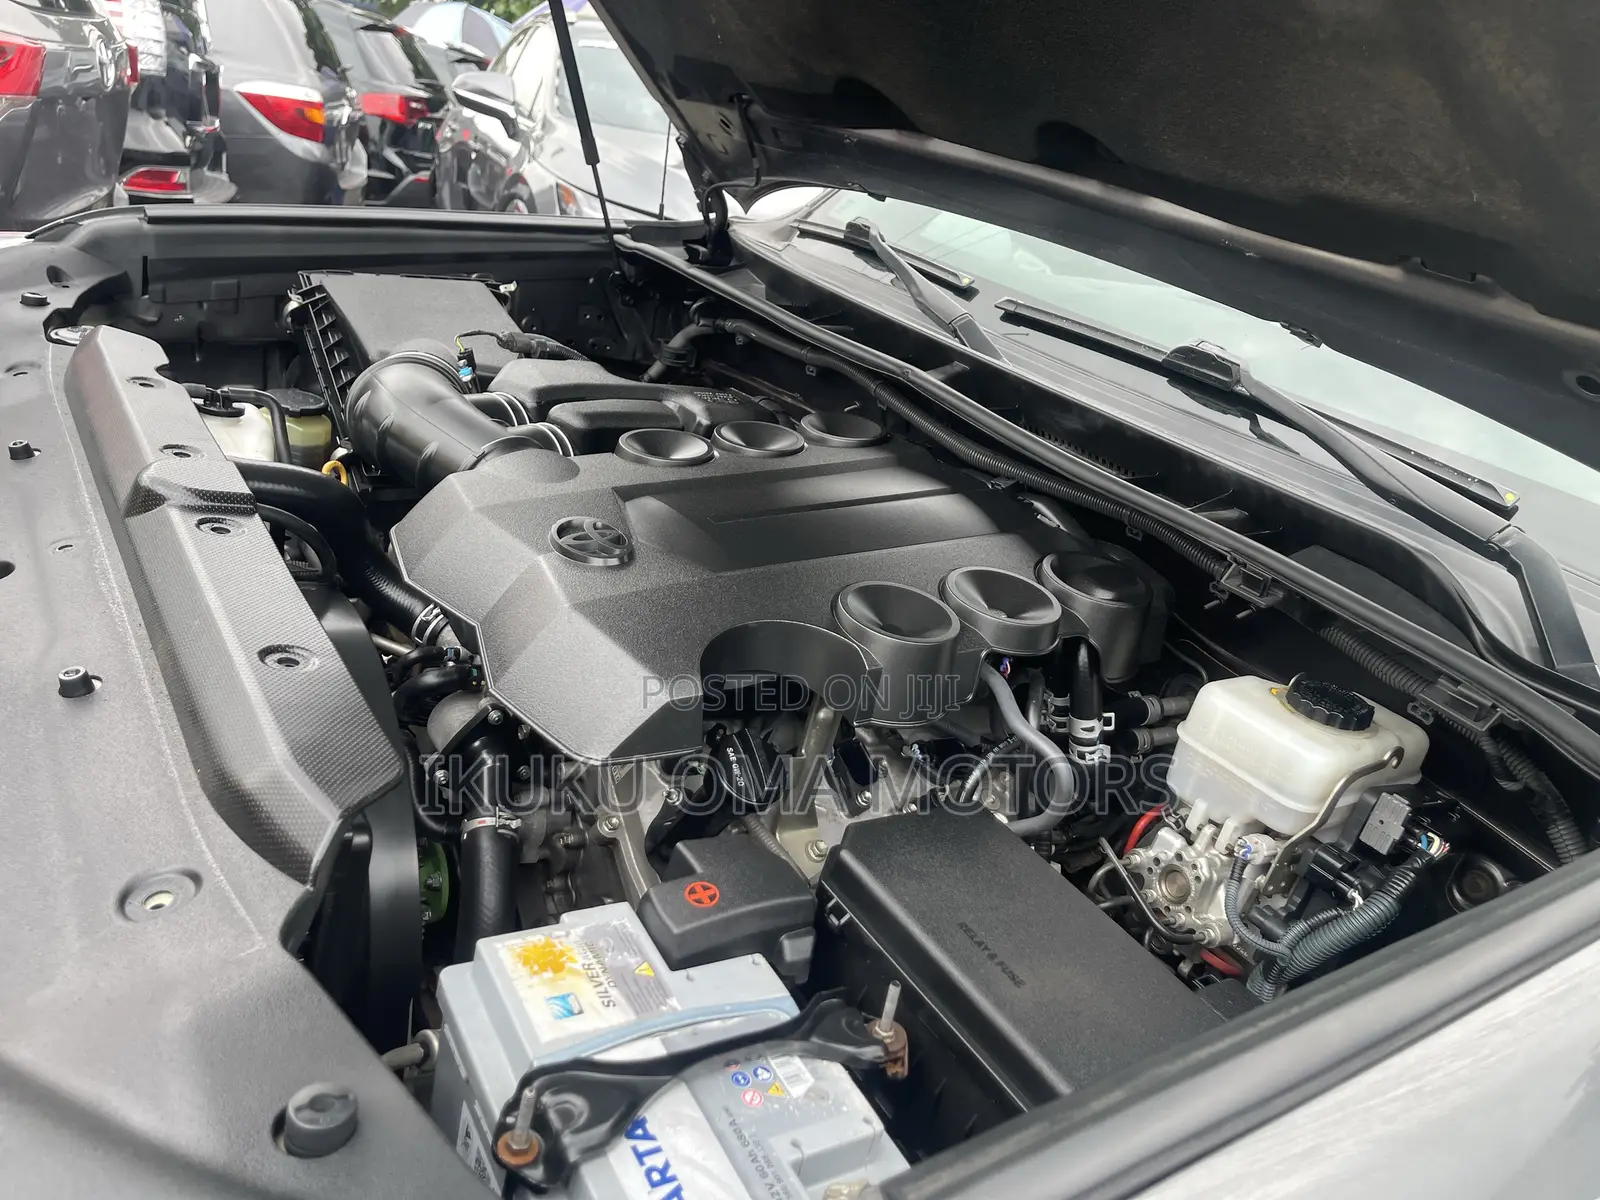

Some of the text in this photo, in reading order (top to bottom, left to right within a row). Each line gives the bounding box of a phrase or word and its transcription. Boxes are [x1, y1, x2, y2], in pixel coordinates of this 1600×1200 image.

[726, 747, 745, 787] SAE 0W-20
[582, 962, 617, 1008] SILVER
